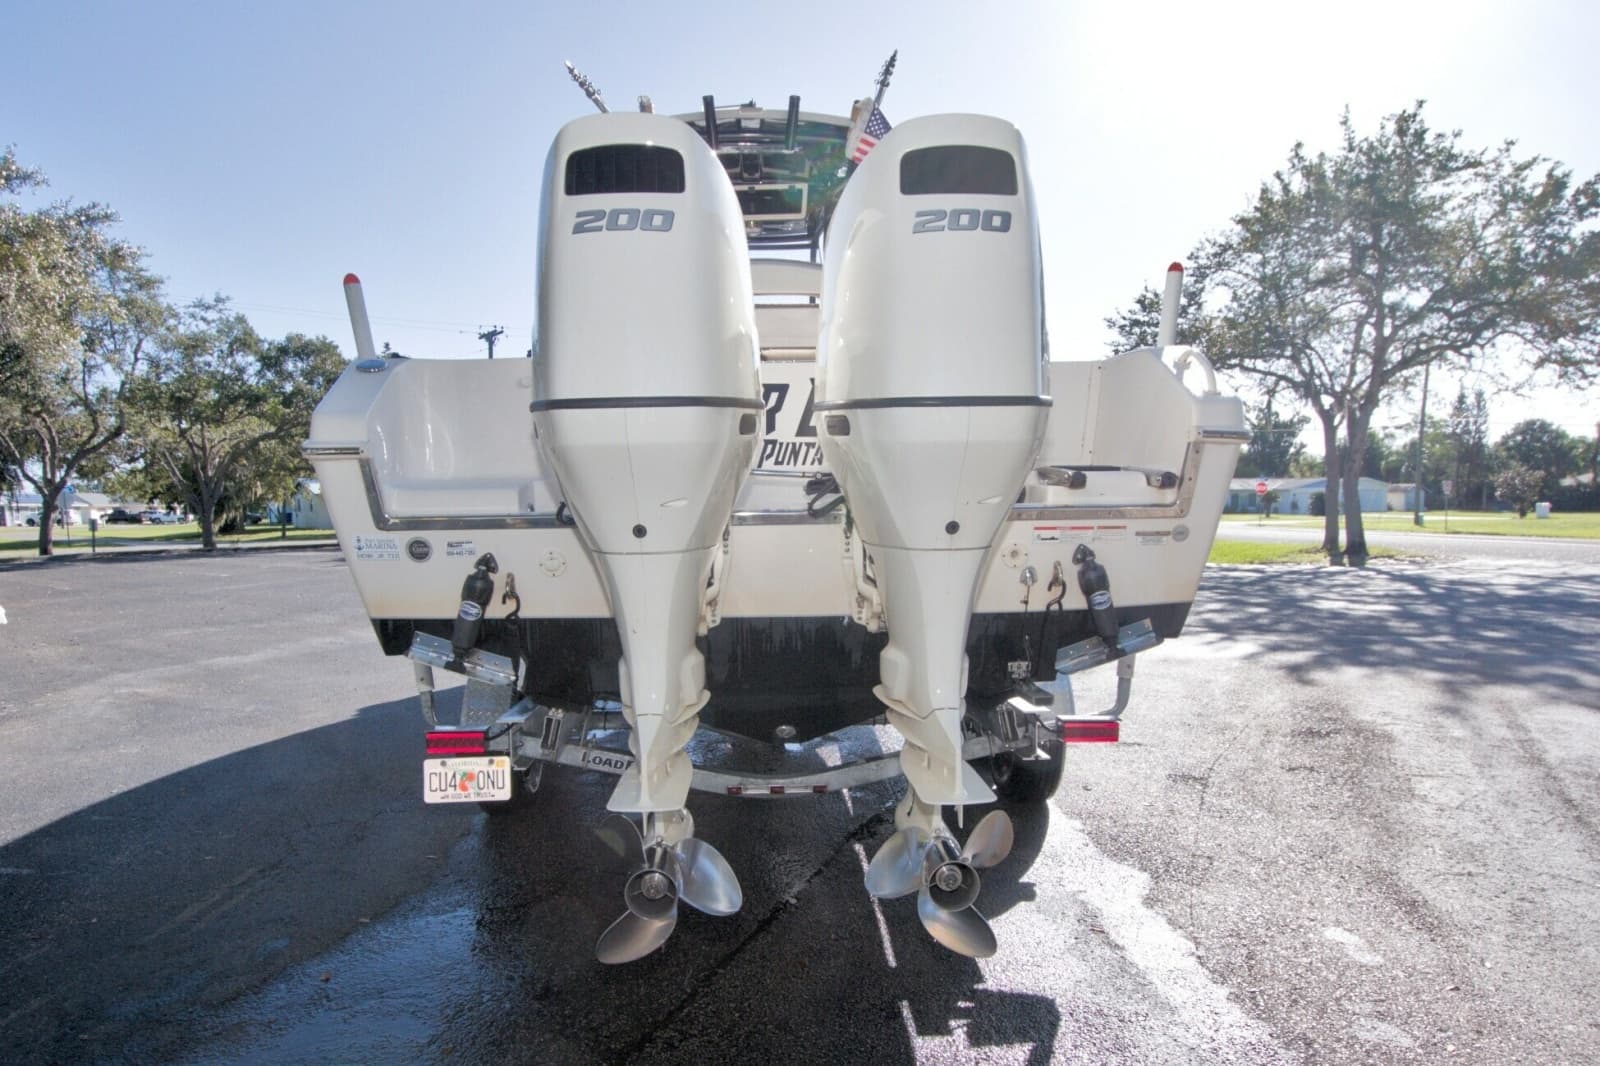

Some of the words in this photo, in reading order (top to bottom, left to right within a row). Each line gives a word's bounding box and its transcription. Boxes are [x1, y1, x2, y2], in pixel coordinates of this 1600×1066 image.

[572, 208, 675, 235] 200
[912, 208, 1012, 234] 200
[757, 439, 824, 468] PUNTA
[429, 771, 457, 792] CU4
